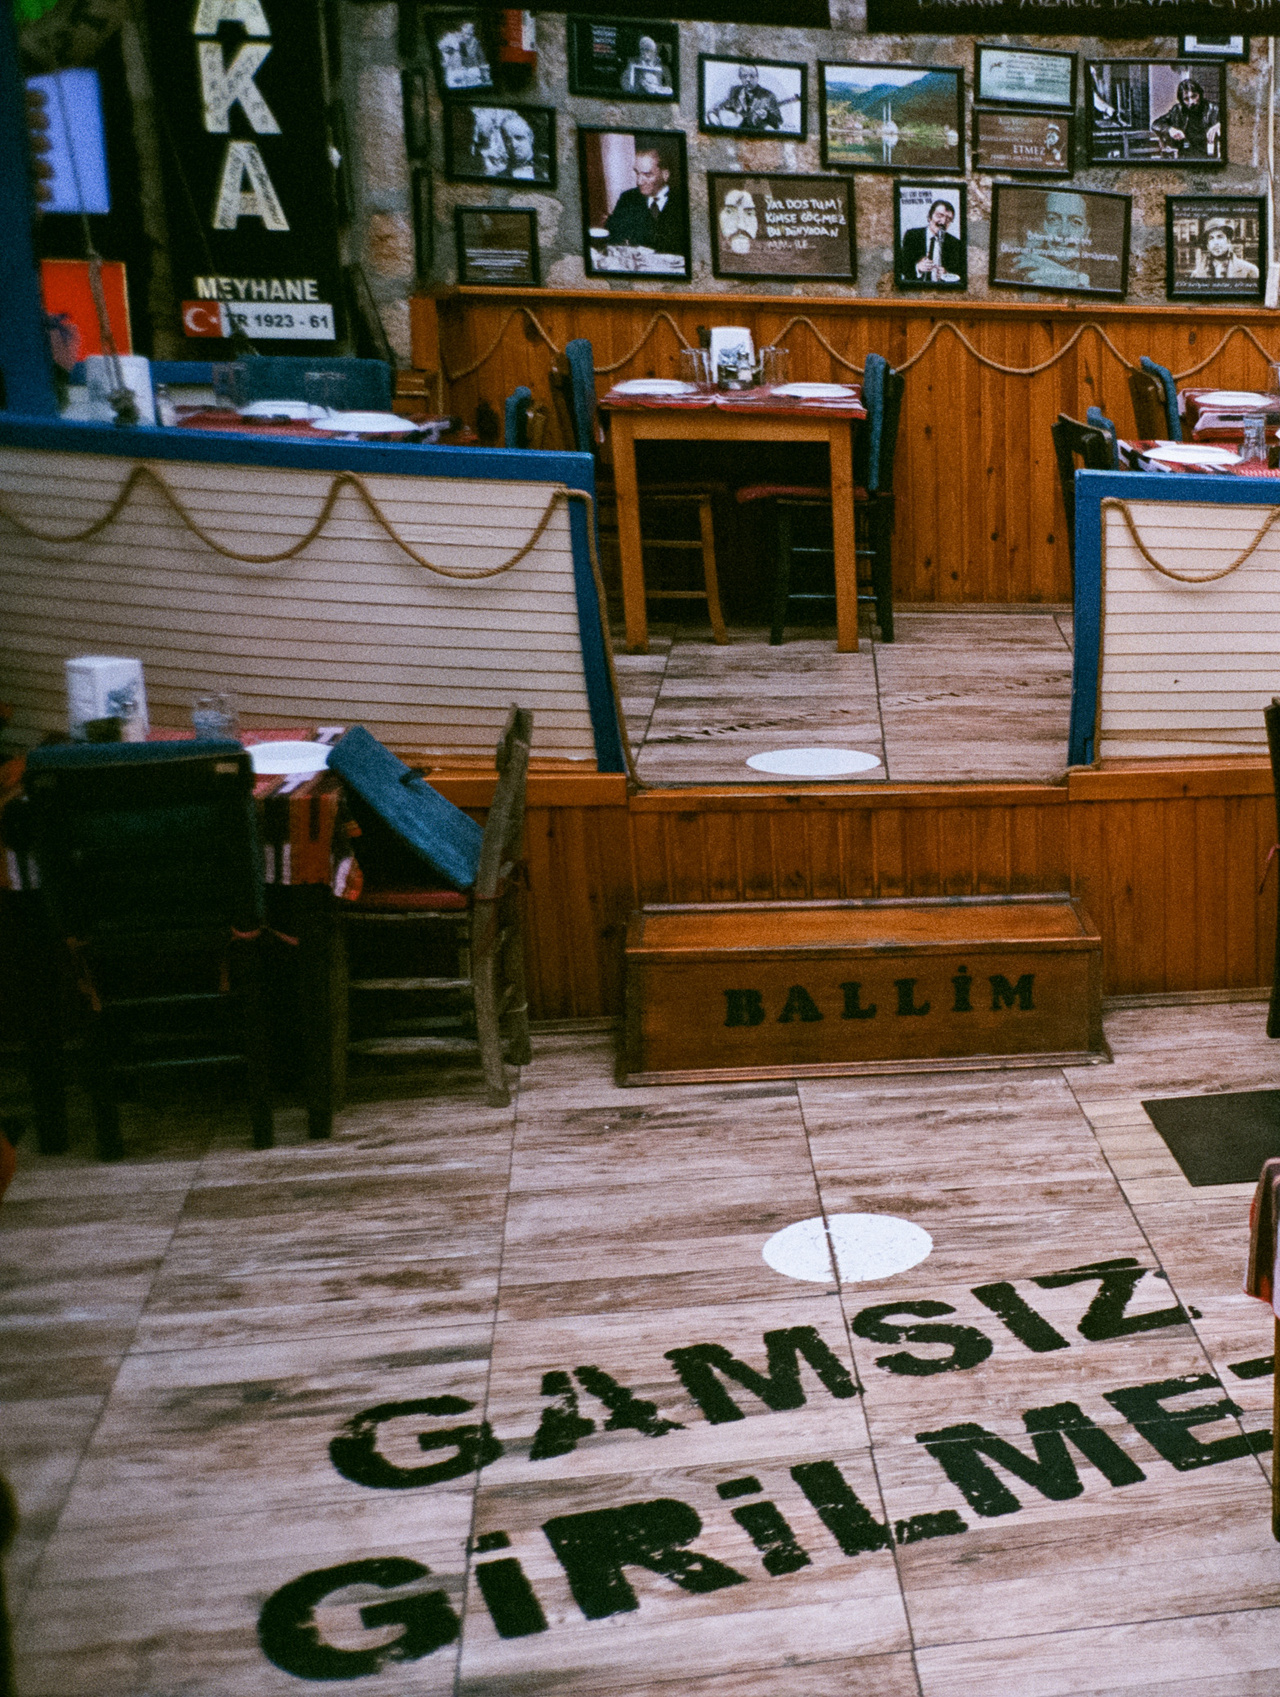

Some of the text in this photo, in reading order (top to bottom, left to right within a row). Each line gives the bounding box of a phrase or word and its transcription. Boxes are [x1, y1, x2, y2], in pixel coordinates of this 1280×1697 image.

[196, 276, 319, 302] MEYHANE
[255, 314, 295, 329] 1923
[310, 314, 329, 329] 61
[327, 1257, 1202, 1491] GAMSIZ
